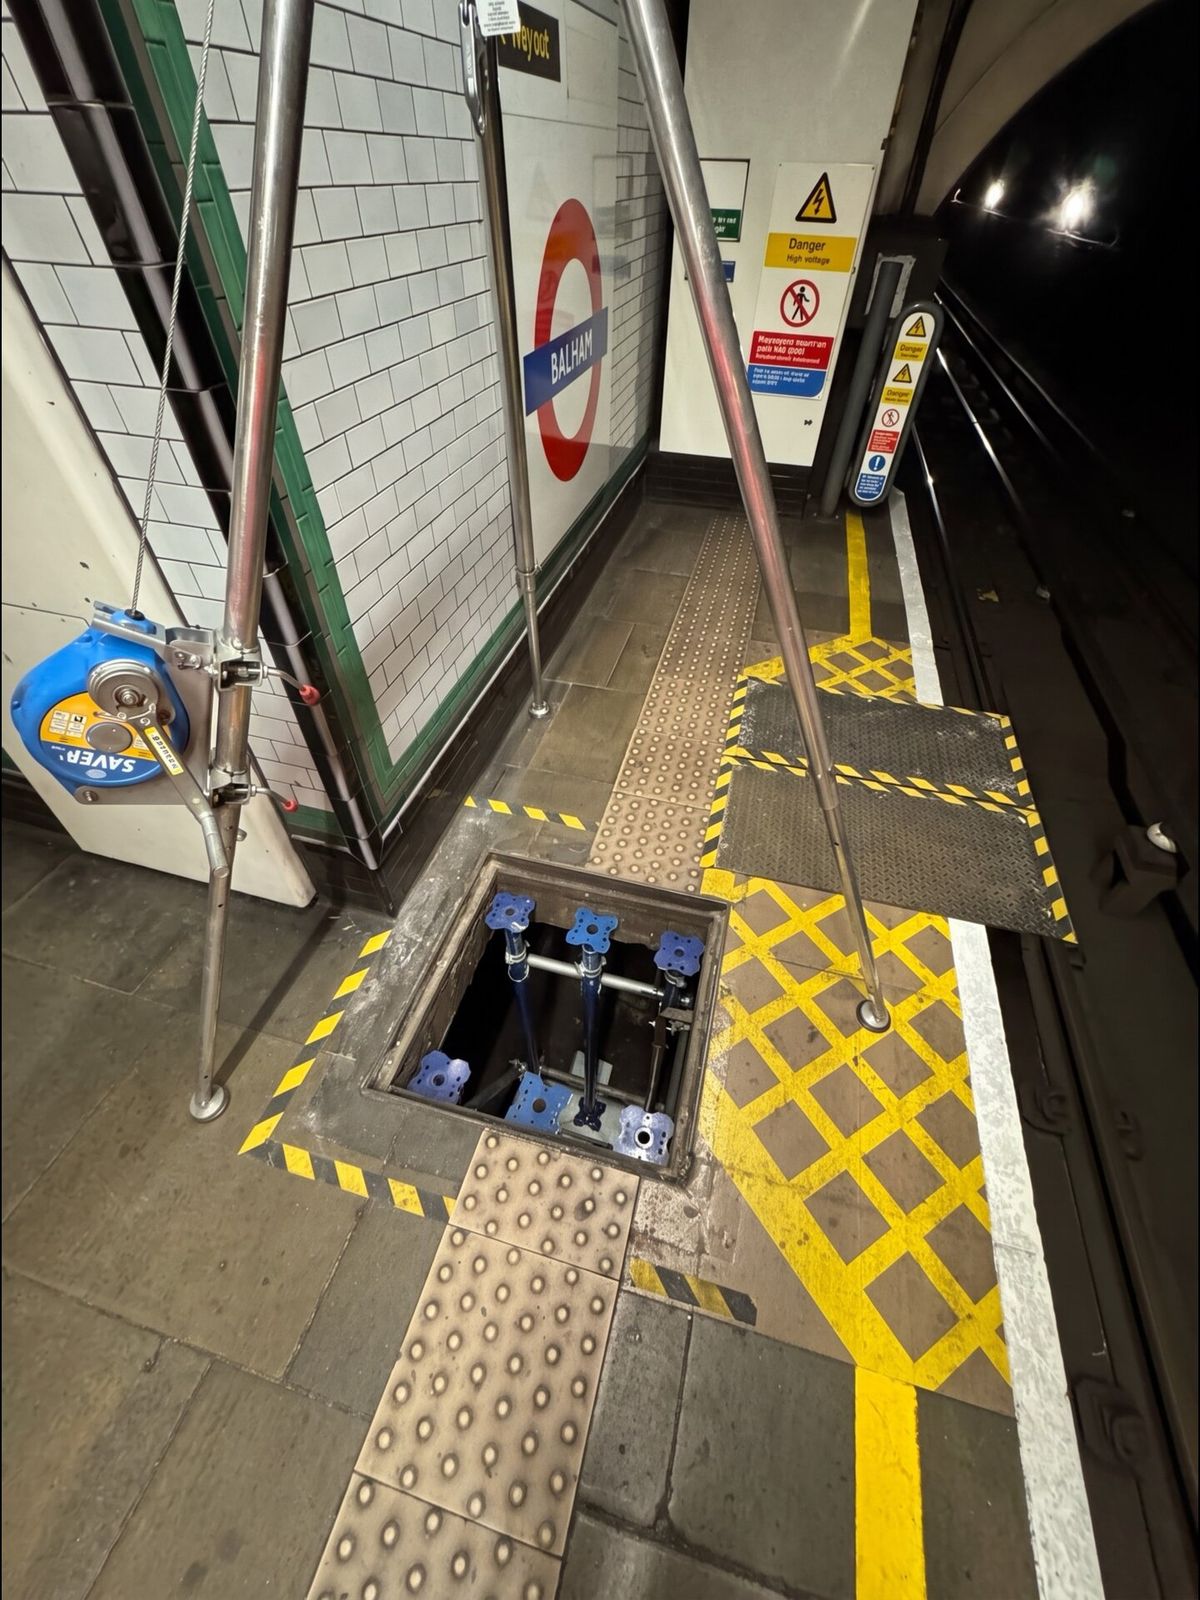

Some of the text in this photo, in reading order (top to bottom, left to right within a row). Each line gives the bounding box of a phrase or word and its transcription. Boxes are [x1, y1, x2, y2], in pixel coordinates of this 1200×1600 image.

[534, 28, 550, 60] out
[789, 238, 827, 254] Danger
[786, 254, 831, 266] High voltage
[550, 328, 593, 385] BALHAM
[900, 344, 924, 353] Danger
[66, 749, 137, 773] SAVER
